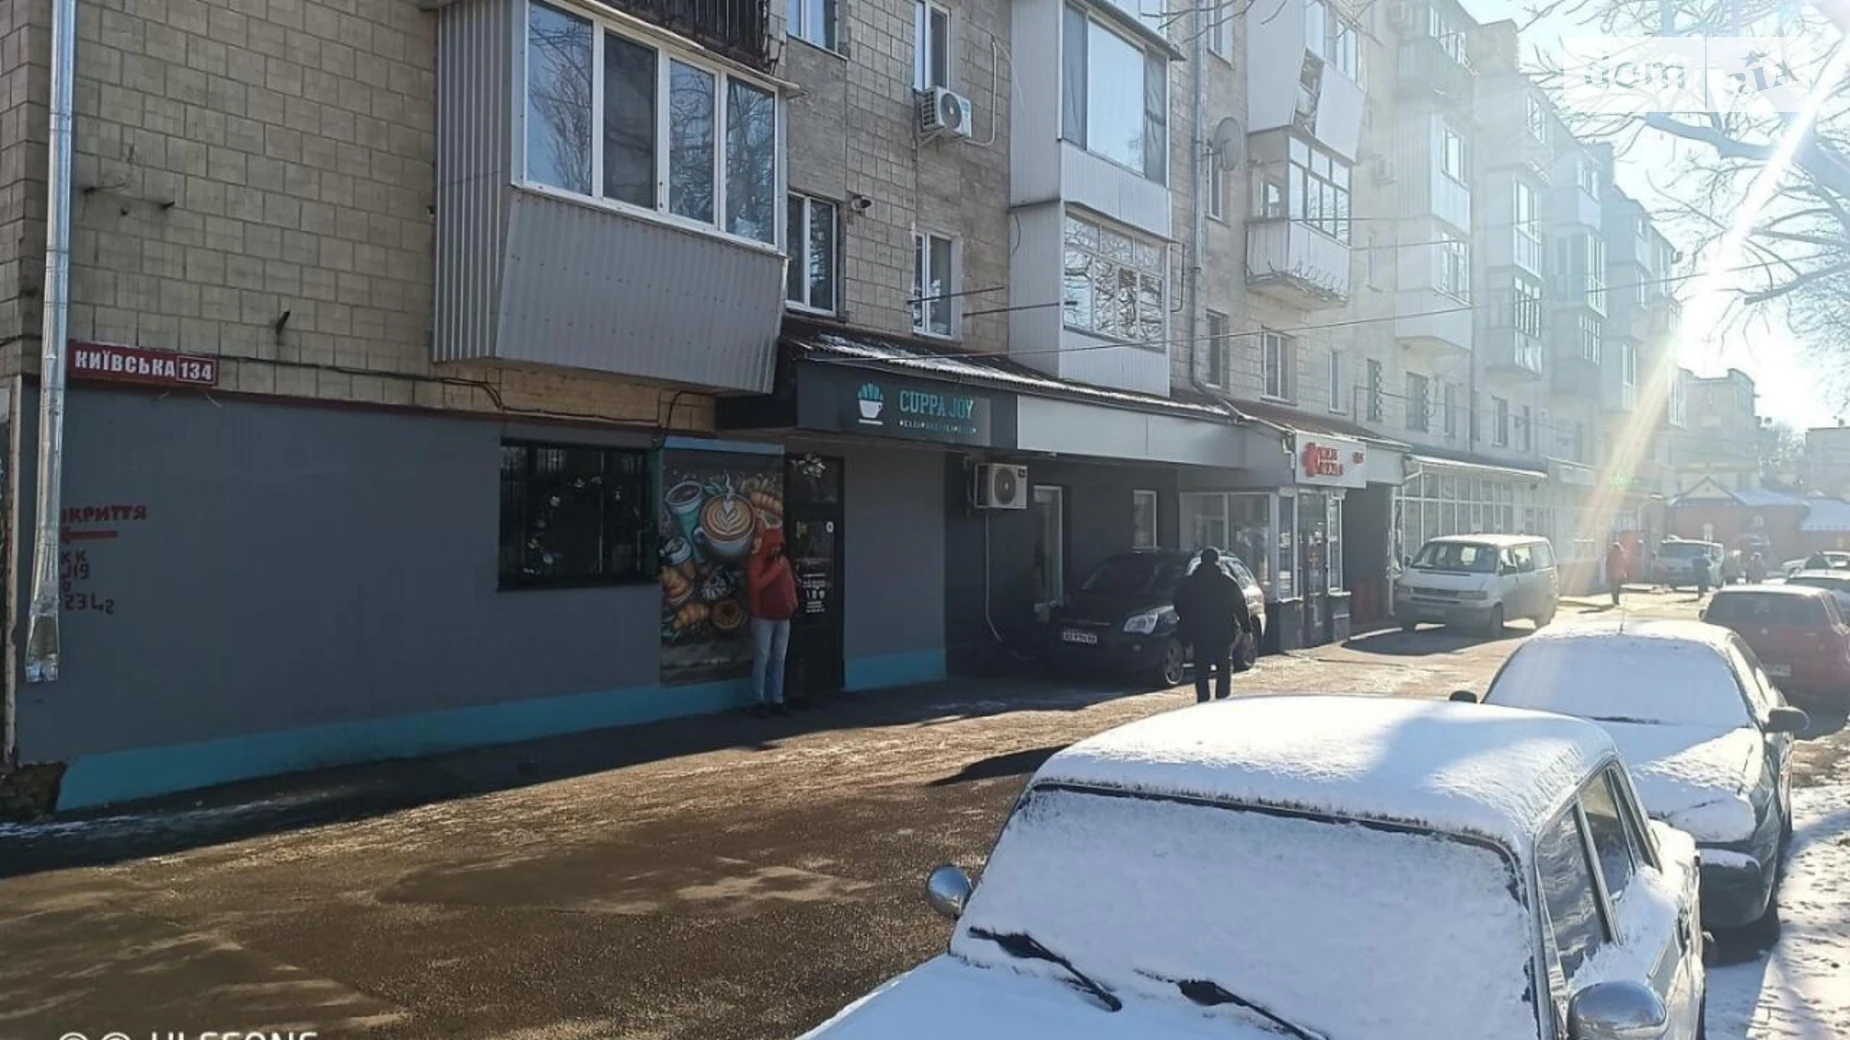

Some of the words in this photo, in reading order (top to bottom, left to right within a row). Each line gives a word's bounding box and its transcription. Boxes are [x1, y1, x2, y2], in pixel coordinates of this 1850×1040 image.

[74, 350, 175, 376] КИЇВСЬКА
[178, 361, 213, 381] 134
[900, 389, 946, 417] CUPPA
[949, 396, 974, 420] JOY
